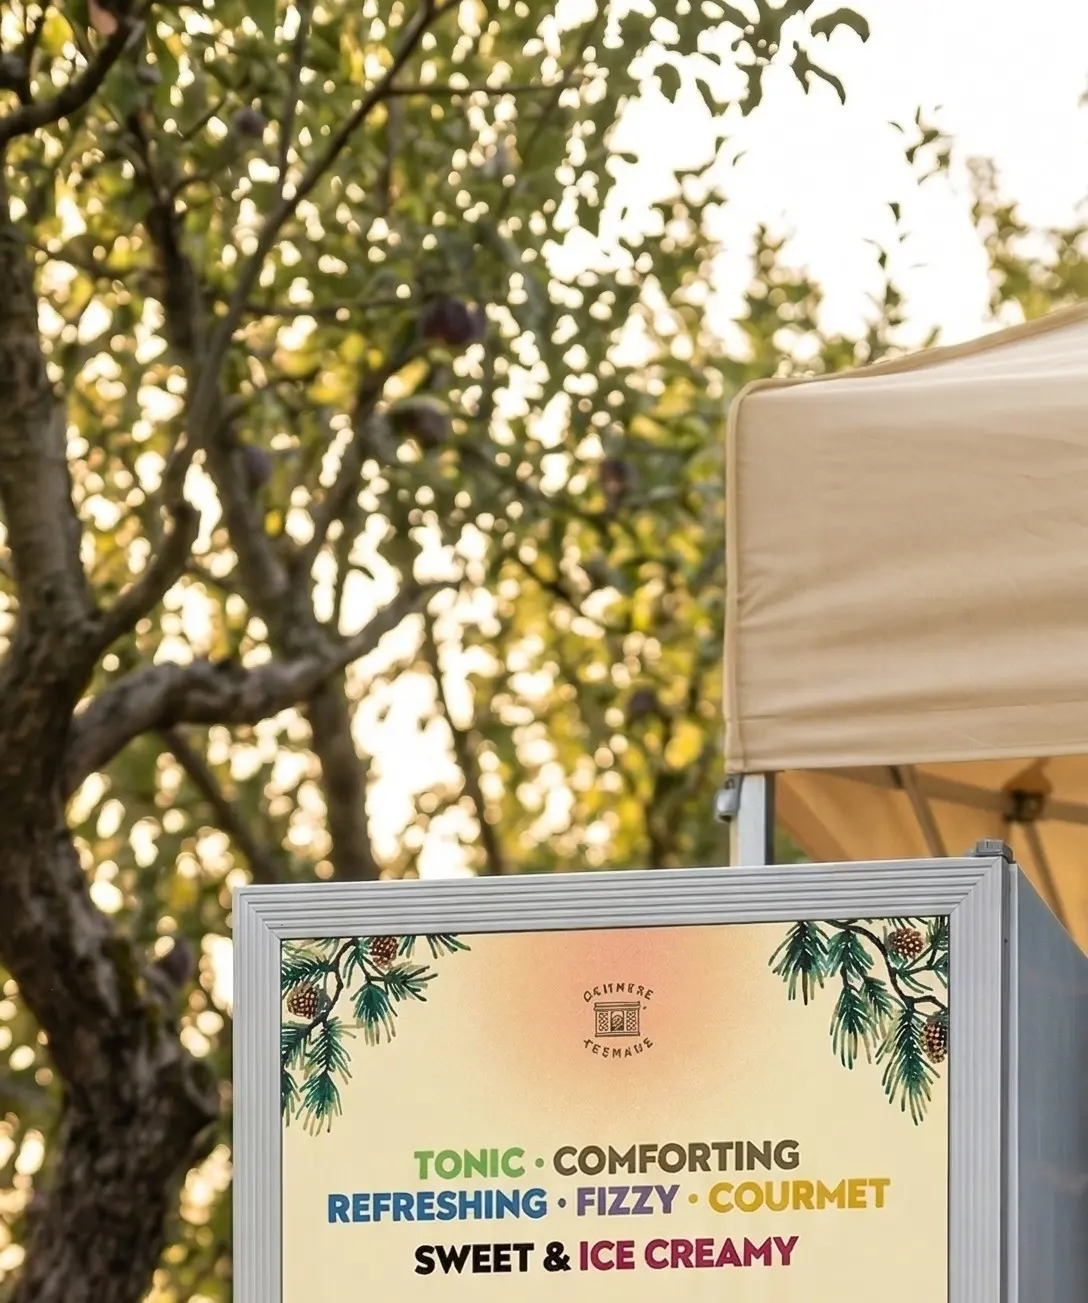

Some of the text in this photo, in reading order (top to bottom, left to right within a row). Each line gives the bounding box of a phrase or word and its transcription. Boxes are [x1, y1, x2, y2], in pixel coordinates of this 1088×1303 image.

[413, 1138, 800, 1181] TONIC COMFORTING
[327, 1186, 549, 1225] REFRESHING
[576, 1183, 681, 1217] FIZZY
[413, 1235, 800, 1277] SWEET & ICE CREAMY
